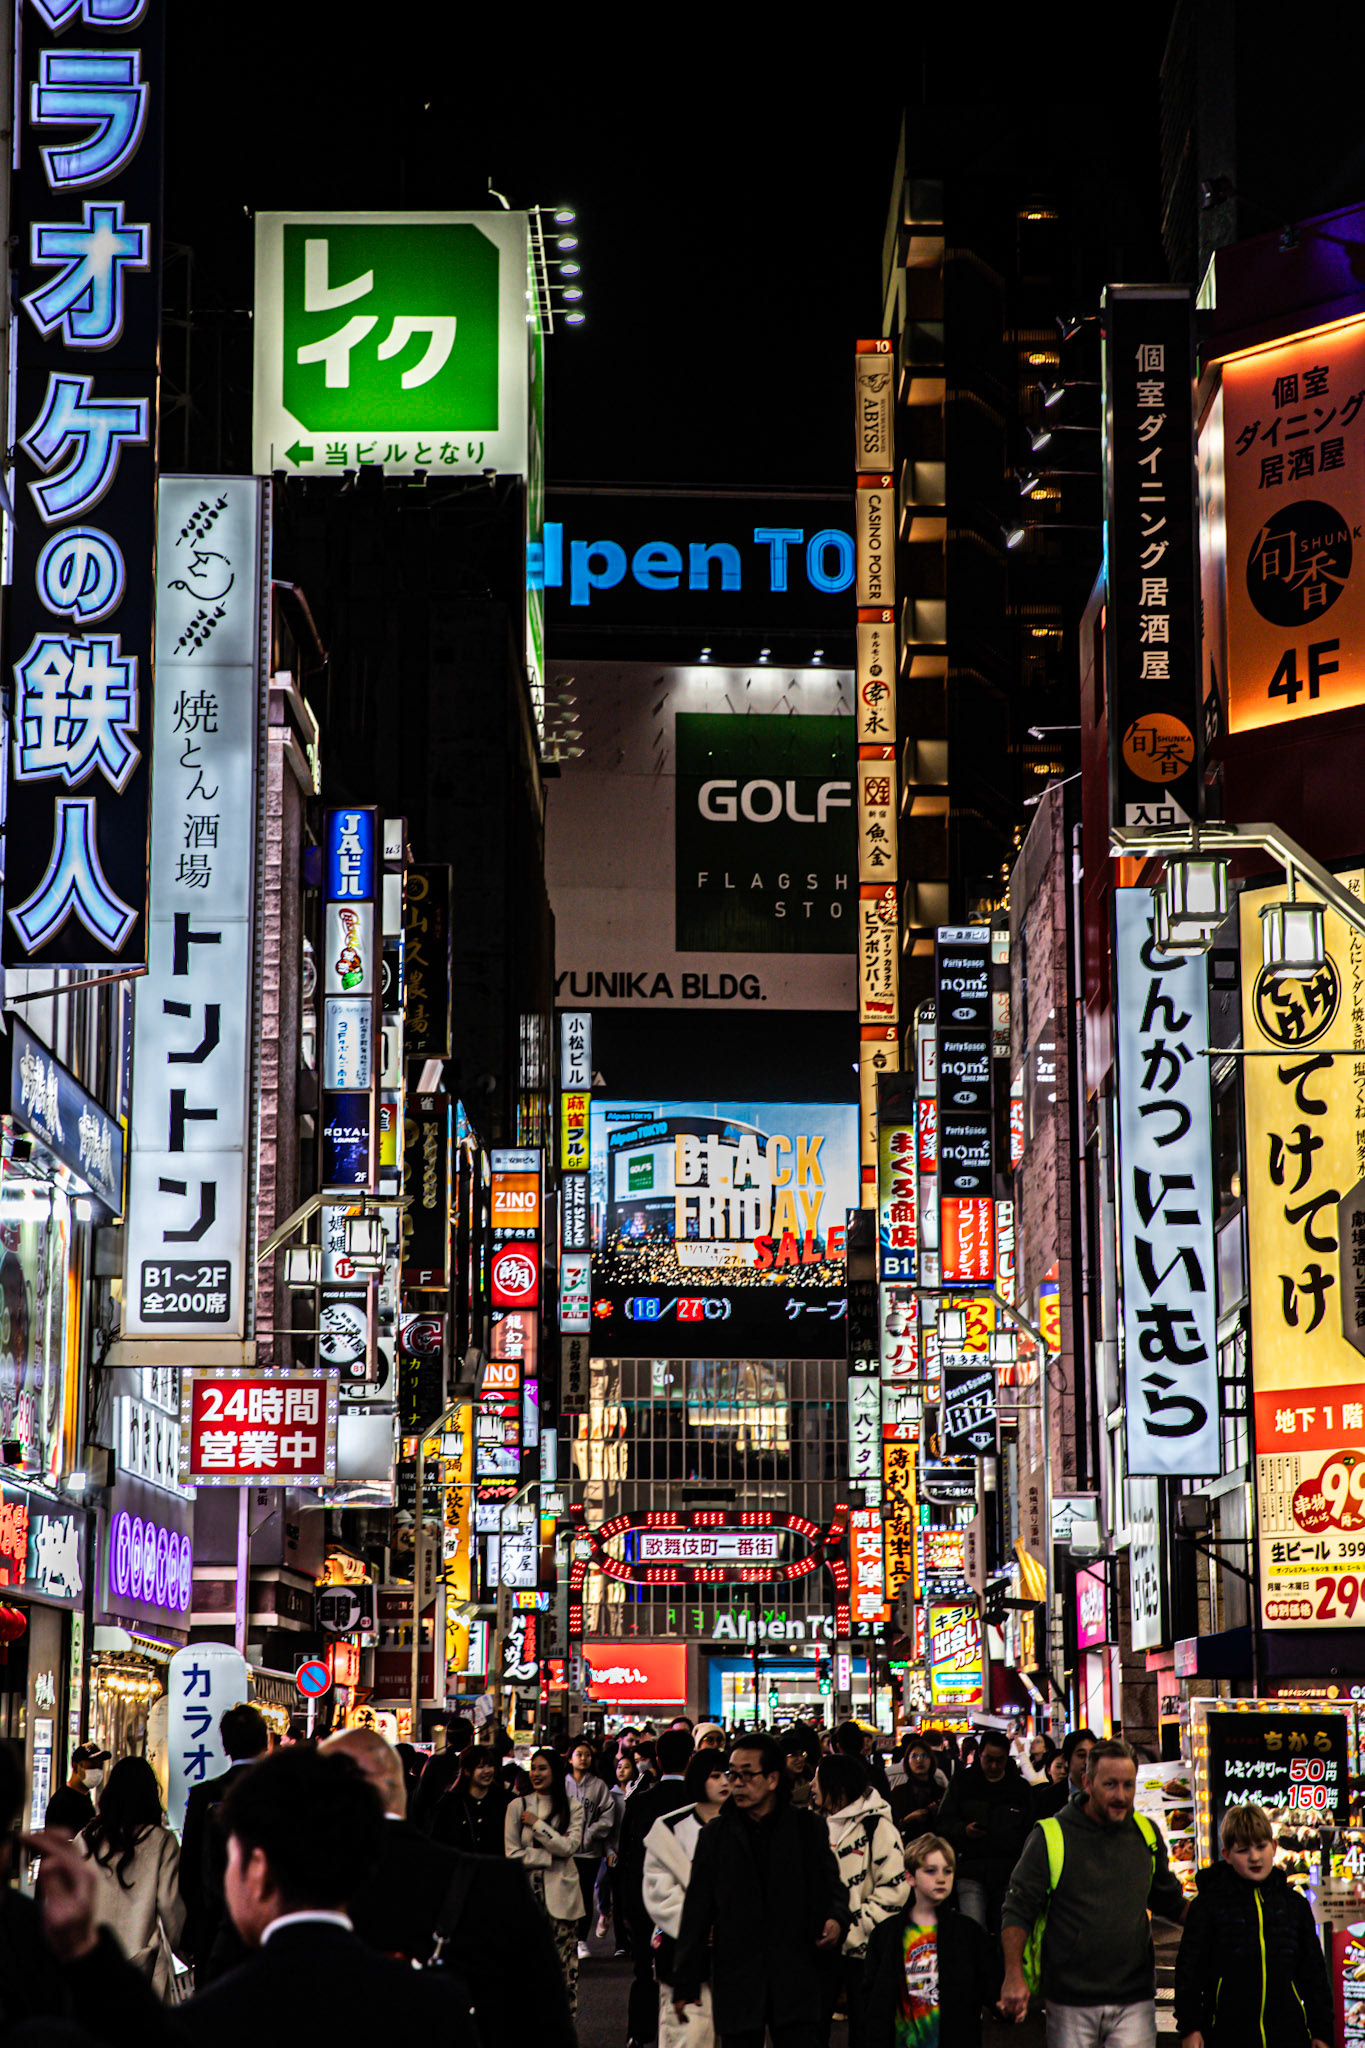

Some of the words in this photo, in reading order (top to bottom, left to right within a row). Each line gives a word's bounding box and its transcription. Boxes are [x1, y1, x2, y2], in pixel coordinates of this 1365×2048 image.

[876, 340, 889, 352] 10
[1271, 365, 1331, 410] 個室
[863, 398, 879, 453] ABYSS
[324, 441, 487, 466] 当ビルとなり
[1256, 435, 1347, 490] 居酒屋
[10, 0, 150, 953] ラオケの鉄人
[881, 476, 891, 488] 9
[868, 494, 882, 550] CASINO
[1135, 342, 1171, 681] 個室ダイニング居酒屋
[543, 522, 742, 606] lpen
[868, 555, 882, 600] POKER
[1249, 525, 1349, 612] 旬香
[882, 611, 891, 623] 8
[1266, 636, 1341, 706] 4F
[1124, 720, 1192, 777] 旬香
[1157, 734, 1192, 743] SHUNKA
[882, 747, 892, 759] 7
[172, 688, 221, 890] 焼とん酒場
[697, 778, 852, 824] GOLF
[1131, 804, 1176, 826] 入口
[336, 814, 364, 896] JAビル
[884, 887, 895, 899] 6
[939, 930, 988, 941] 第一桑原ビル
[942, 957, 962, 968] Party
[962, 957, 985, 968] Space
[552, 972, 674, 1000] YUNIKA
[682, 974, 768, 1001] BLDG.
[958, 1010, 970, 1018] 5F
[886, 1027, 896, 1040] 5
[944, 1042, 963, 1053] Party
[963, 1042, 986, 1052] Space
[568, 1017, 585, 1085] 小松ビル
[157, 911, 222, 1243] トントン
[959, 1093, 971, 1102] 4F
[323, 1127, 370, 1137] ROYAL
[945, 1125, 964, 1136] Party
[964, 1125, 988, 1135] Space
[422, 1121, 439, 1209] MAHJONG
[568, 1157, 583, 1168] 6F
[674, 1133, 825, 1187] BLACK
[354, 1171, 368, 1183] 2F
[564, 1176, 573, 1201] DARTS
[573, 1176, 586, 1205] BUZZ
[889, 1130, 916, 1251] まぐろ商店
[960, 1177, 973, 1187] 3F
[494, 1191, 537, 1208] ZINO
[1267, 1053, 1342, 1335] てけてけ
[564, 1209, 573, 1247] KARAOKE
[573, 1207, 586, 1247] STAND
[674, 1189, 825, 1240] FRIDAY
[753, 1225, 847, 1270] SALE
[957, 1199, 975, 1280] リフレッシュ
[142, 1292, 228, 1316] 全200席
[504, 1314, 524, 1360] 龍幻酒
[854, 1358, 880, 1372] 3F
[523, 1383, 538, 1395] 2F
[945, 1383, 966, 1400] Party
[966, 1371, 993, 1389] Space
[199, 1386, 321, 1427] 24時間
[893, 1424, 919, 1439] 4F
[974, 1435, 988, 1443] B1
[199, 1430, 319, 1470] 営業中
[1294, 1494, 1326, 1518] 串物
[645, 1536, 775, 1557] 歌舞伎町一番街
[1271, 1540, 1331, 1564] 生ビール
[1267, 1602, 1312, 1619] 特別価格
[1314, 1574, 1365, 1622] 29
[711, 1613, 806, 1646] Alpen
[857, 1622, 885, 1637] 2F
[934, 1602, 977, 1631] キラリ
[933, 1618, 982, 1662] 出会い
[181, 1662, 215, 1782] カラオ
[1263, 1730, 1333, 1753] ちから
[1224, 1759, 1288, 1779] レモンサワー
[1288, 1757, 1326, 1783] 50
[1324, 1769, 1338, 1782] 円
[1224, 1788, 1288, 1810] ハイボール
[1287, 1783, 1328, 1811] 150
[1325, 1796, 1339, 1810] 円
